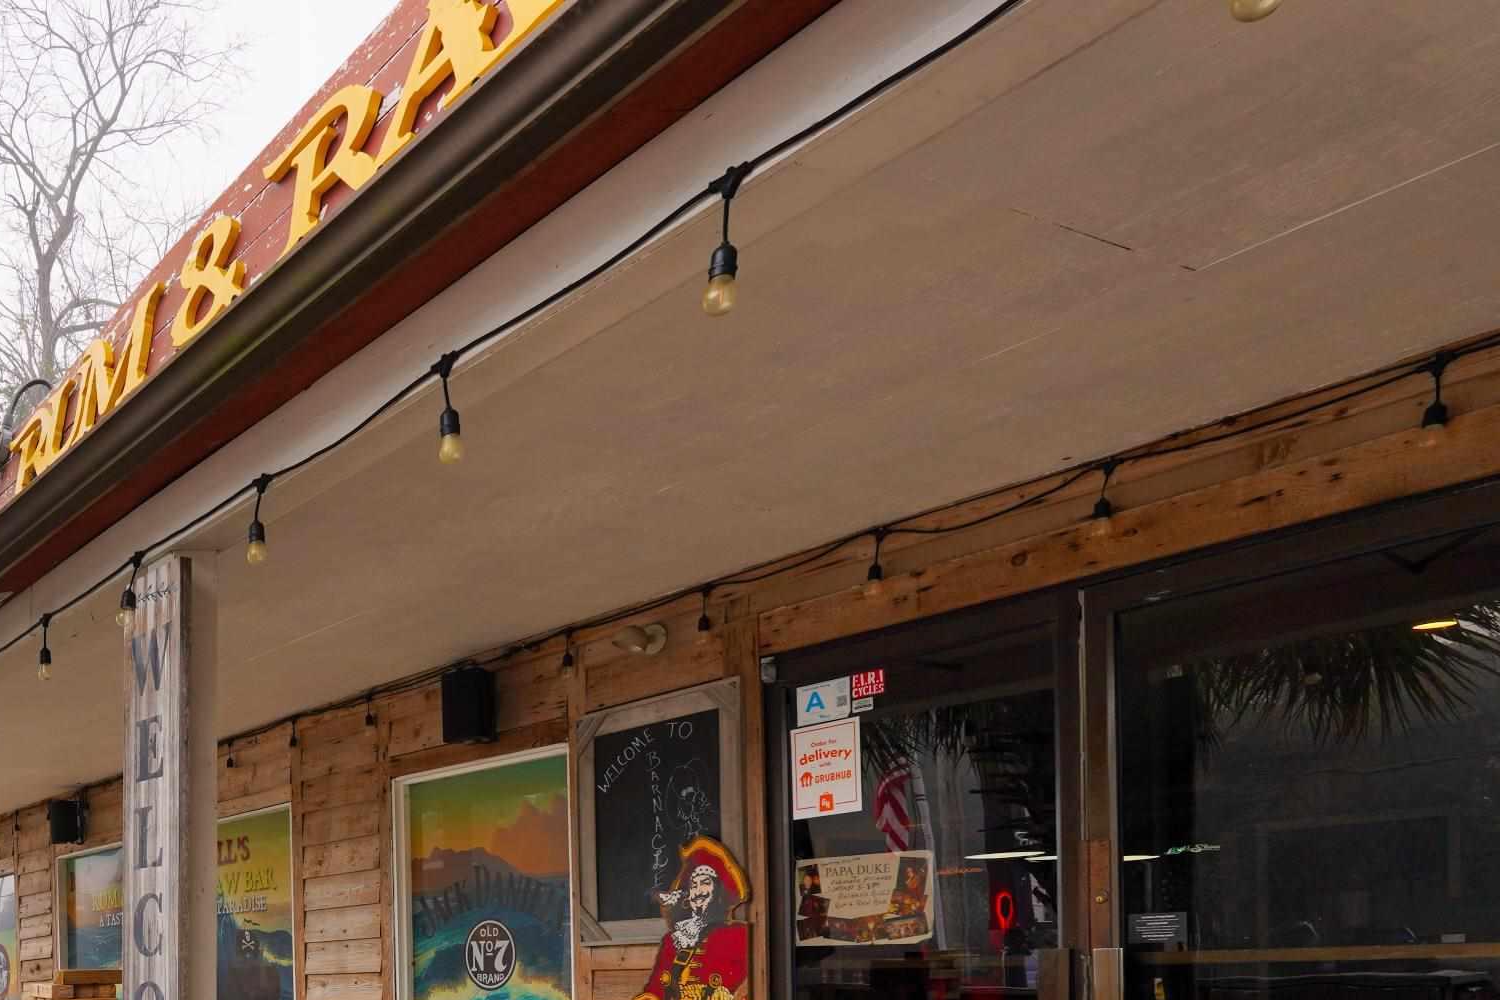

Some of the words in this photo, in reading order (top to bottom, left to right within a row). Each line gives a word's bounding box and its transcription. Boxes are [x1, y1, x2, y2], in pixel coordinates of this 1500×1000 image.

[10, 282, 164, 494] RUM
[171, 214, 246, 348] &
[852, 683, 884, 699] CYCLES
[805, 691, 826, 712] A
[597, 728, 655, 793] WELCOME
[667, 721, 693, 739] TO
[799, 748, 853, 766] delivery
[814, 769, 852, 784] GRUBHUB
[217, 835, 251, 865] LL'S
[826, 866, 855, 878] PAPA
[856, 863, 891, 876] DUKE
[106, 911, 124, 928] TAST
[480, 925, 499, 937] OLD
[476, 973, 505, 985] BRAND
